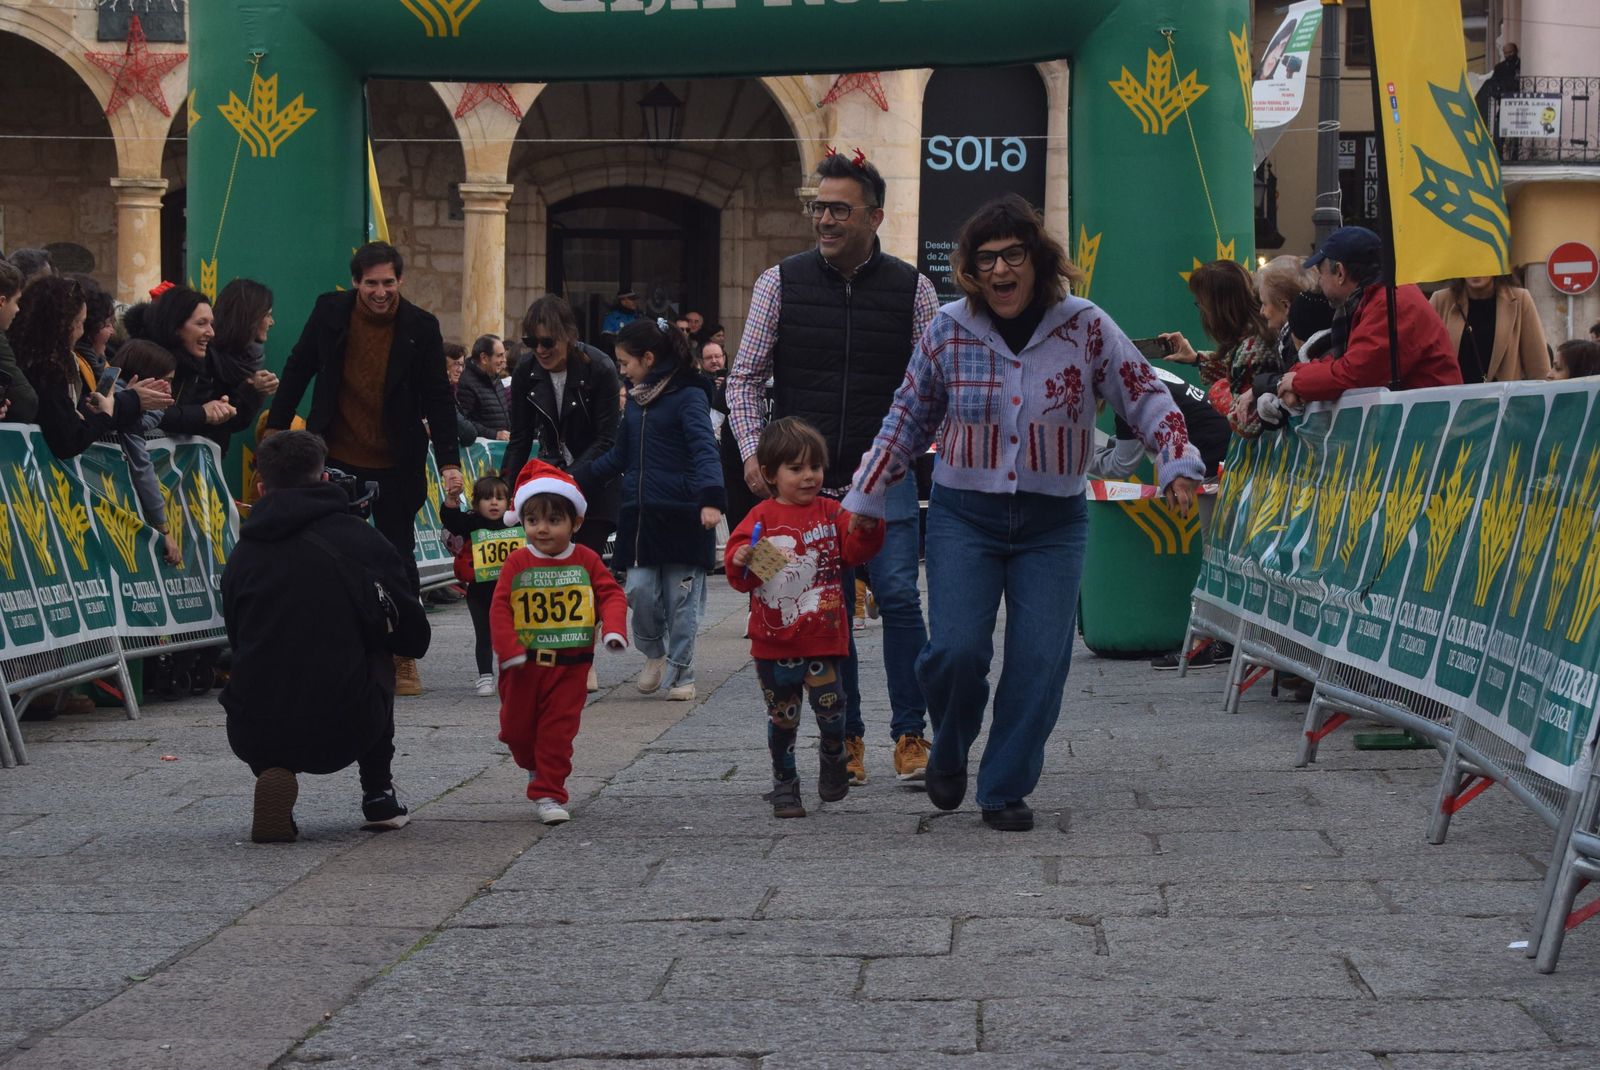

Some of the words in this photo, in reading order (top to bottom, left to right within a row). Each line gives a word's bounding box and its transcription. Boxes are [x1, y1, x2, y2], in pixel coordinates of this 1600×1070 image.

[1367, 139, 1378, 217] VENDE
[925, 241, 950, 249] Desde
[927, 252, 937, 260] de
[534, 578, 553, 586] CAJA
[555, 576, 582, 586] RURAL
[518, 589, 583, 624] 1352
[1399, 601, 1417, 629] CAJA
[1414, 605, 1441, 637] RURAL
[537, 634, 559, 643] CAJA
[561, 631, 589, 642] RURAL
[1446, 615, 1467, 646] CAJA
[1398, 632, 1408, 649] DE
[1405, 634, 1426, 656] ZAMORA
[1446, 649, 1457, 666] DE
